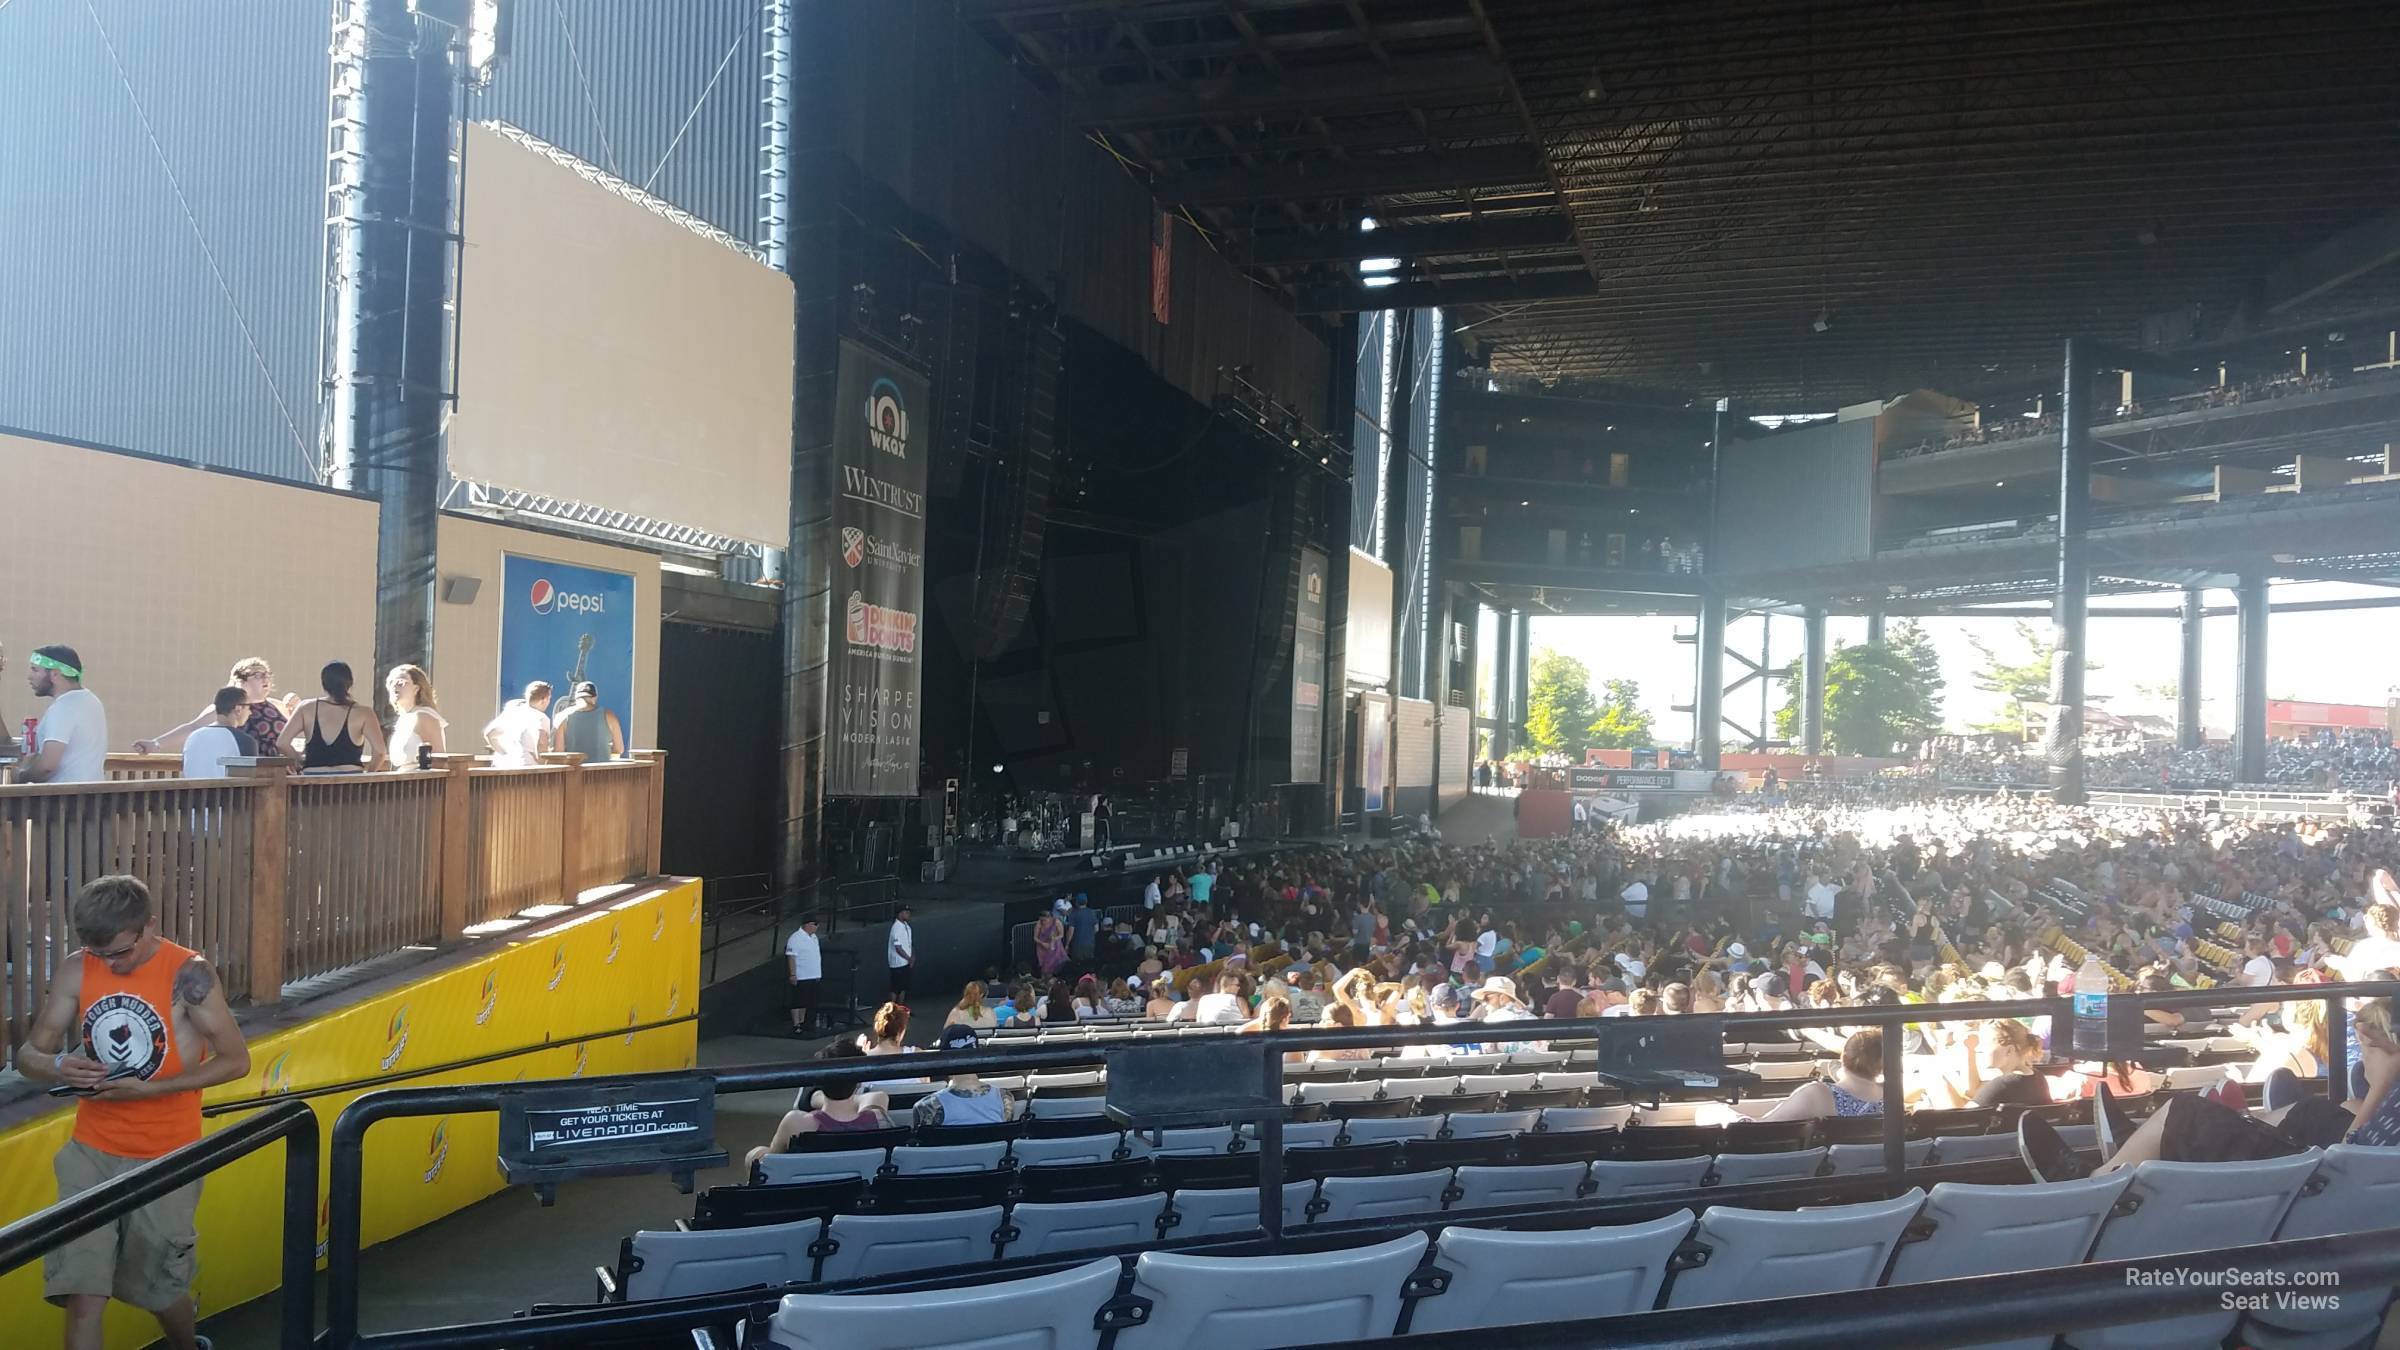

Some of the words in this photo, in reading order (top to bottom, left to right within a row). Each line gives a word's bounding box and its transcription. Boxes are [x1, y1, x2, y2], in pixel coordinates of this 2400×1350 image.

[870, 395, 906, 440] 101
[870, 429, 906, 459] WKQX
[844, 465, 922, 513] WINTRUST
[557, 591, 604, 616] pepsi
[869, 626, 914, 652] DONUTS
[844, 684, 913, 708] SHARPE
[842, 707, 912, 730] VISION
[843, 732, 881, 744] MODERN
[885, 736, 911, 746] LASIK
[1616, 775, 1656, 785] PERFORMANCE
[85, 998, 117, 1026] TOUGH
[121, 997, 161, 1032] MUDDER
[560, 1117, 579, 1126] GET
[581, 1114, 608, 1125] YOUR
[611, 1112, 649, 1122] TICKETS
[651, 1110, 664, 1119] AT
[616, 1103, 638, 1112] TIME
